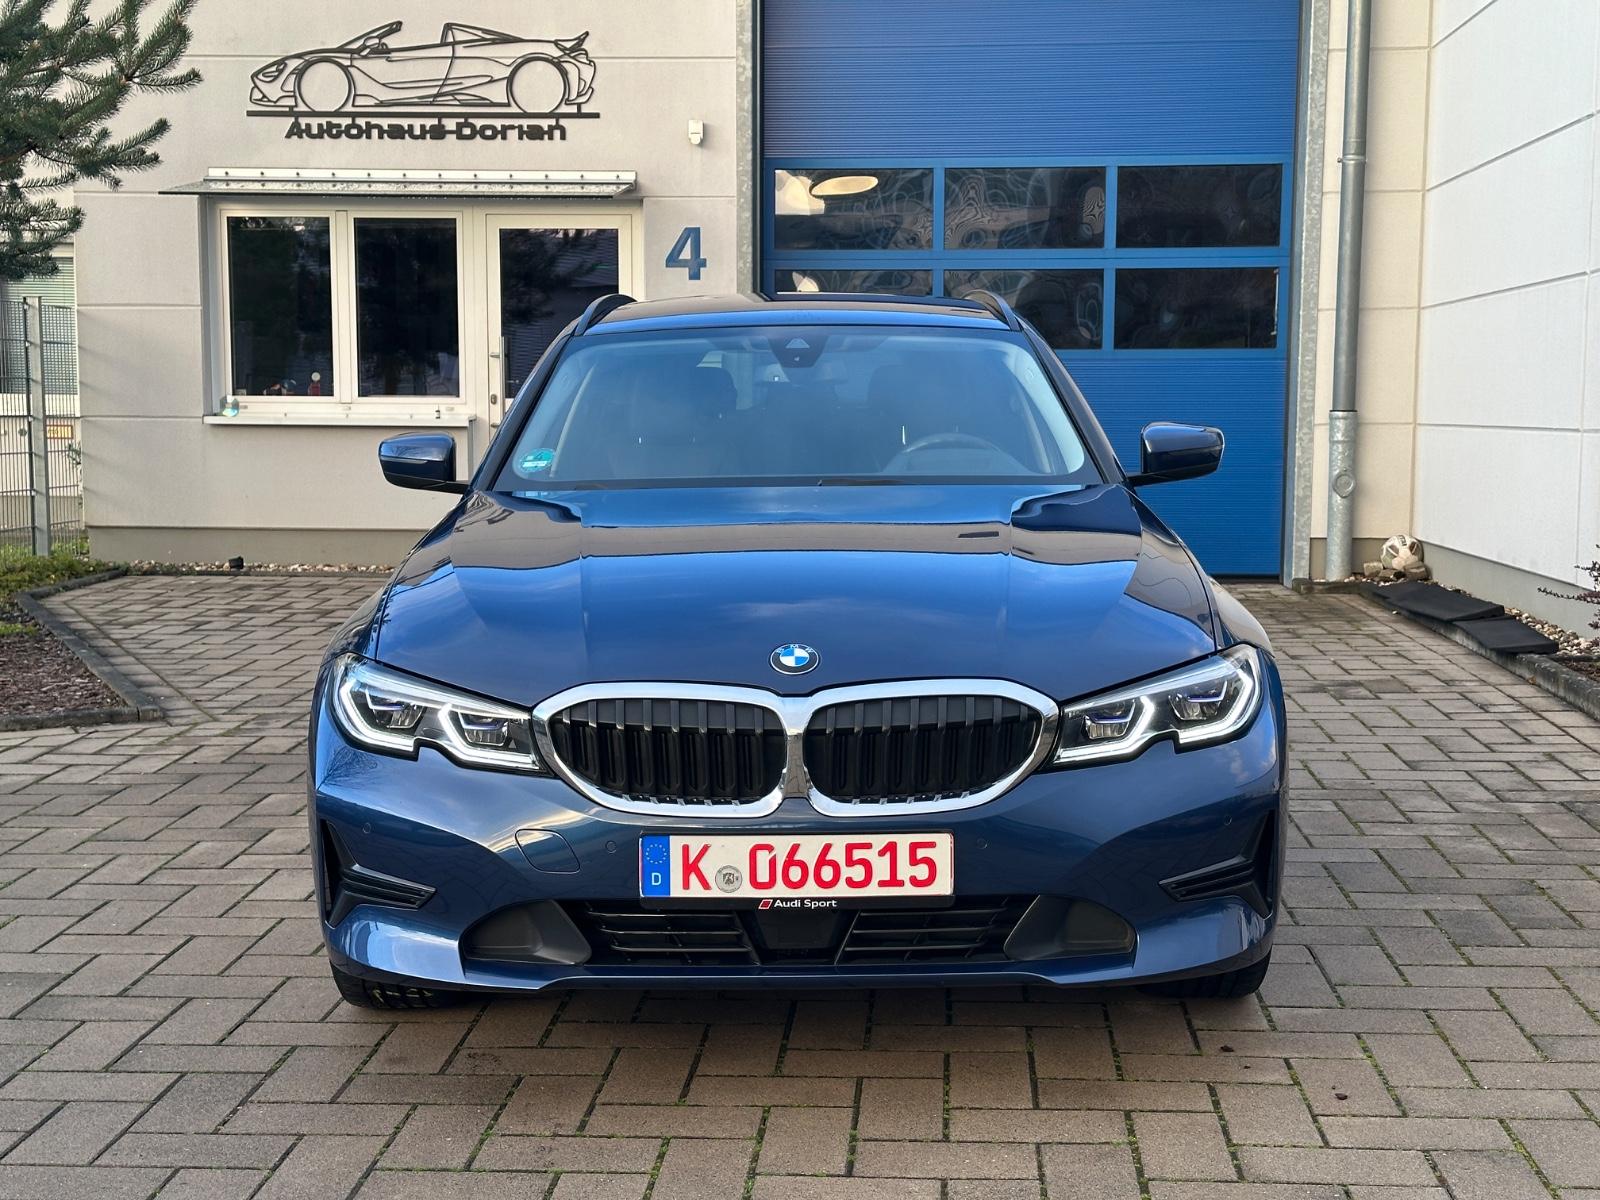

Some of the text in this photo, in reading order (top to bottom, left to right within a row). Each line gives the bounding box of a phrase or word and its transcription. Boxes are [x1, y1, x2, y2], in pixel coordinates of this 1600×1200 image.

[665, 226, 707, 280] 4
[651, 872, 662, 886] D
[682, 844, 712, 890] K
[749, 841, 937, 889] 066515
[774, 899, 837, 910] Audi Sport
